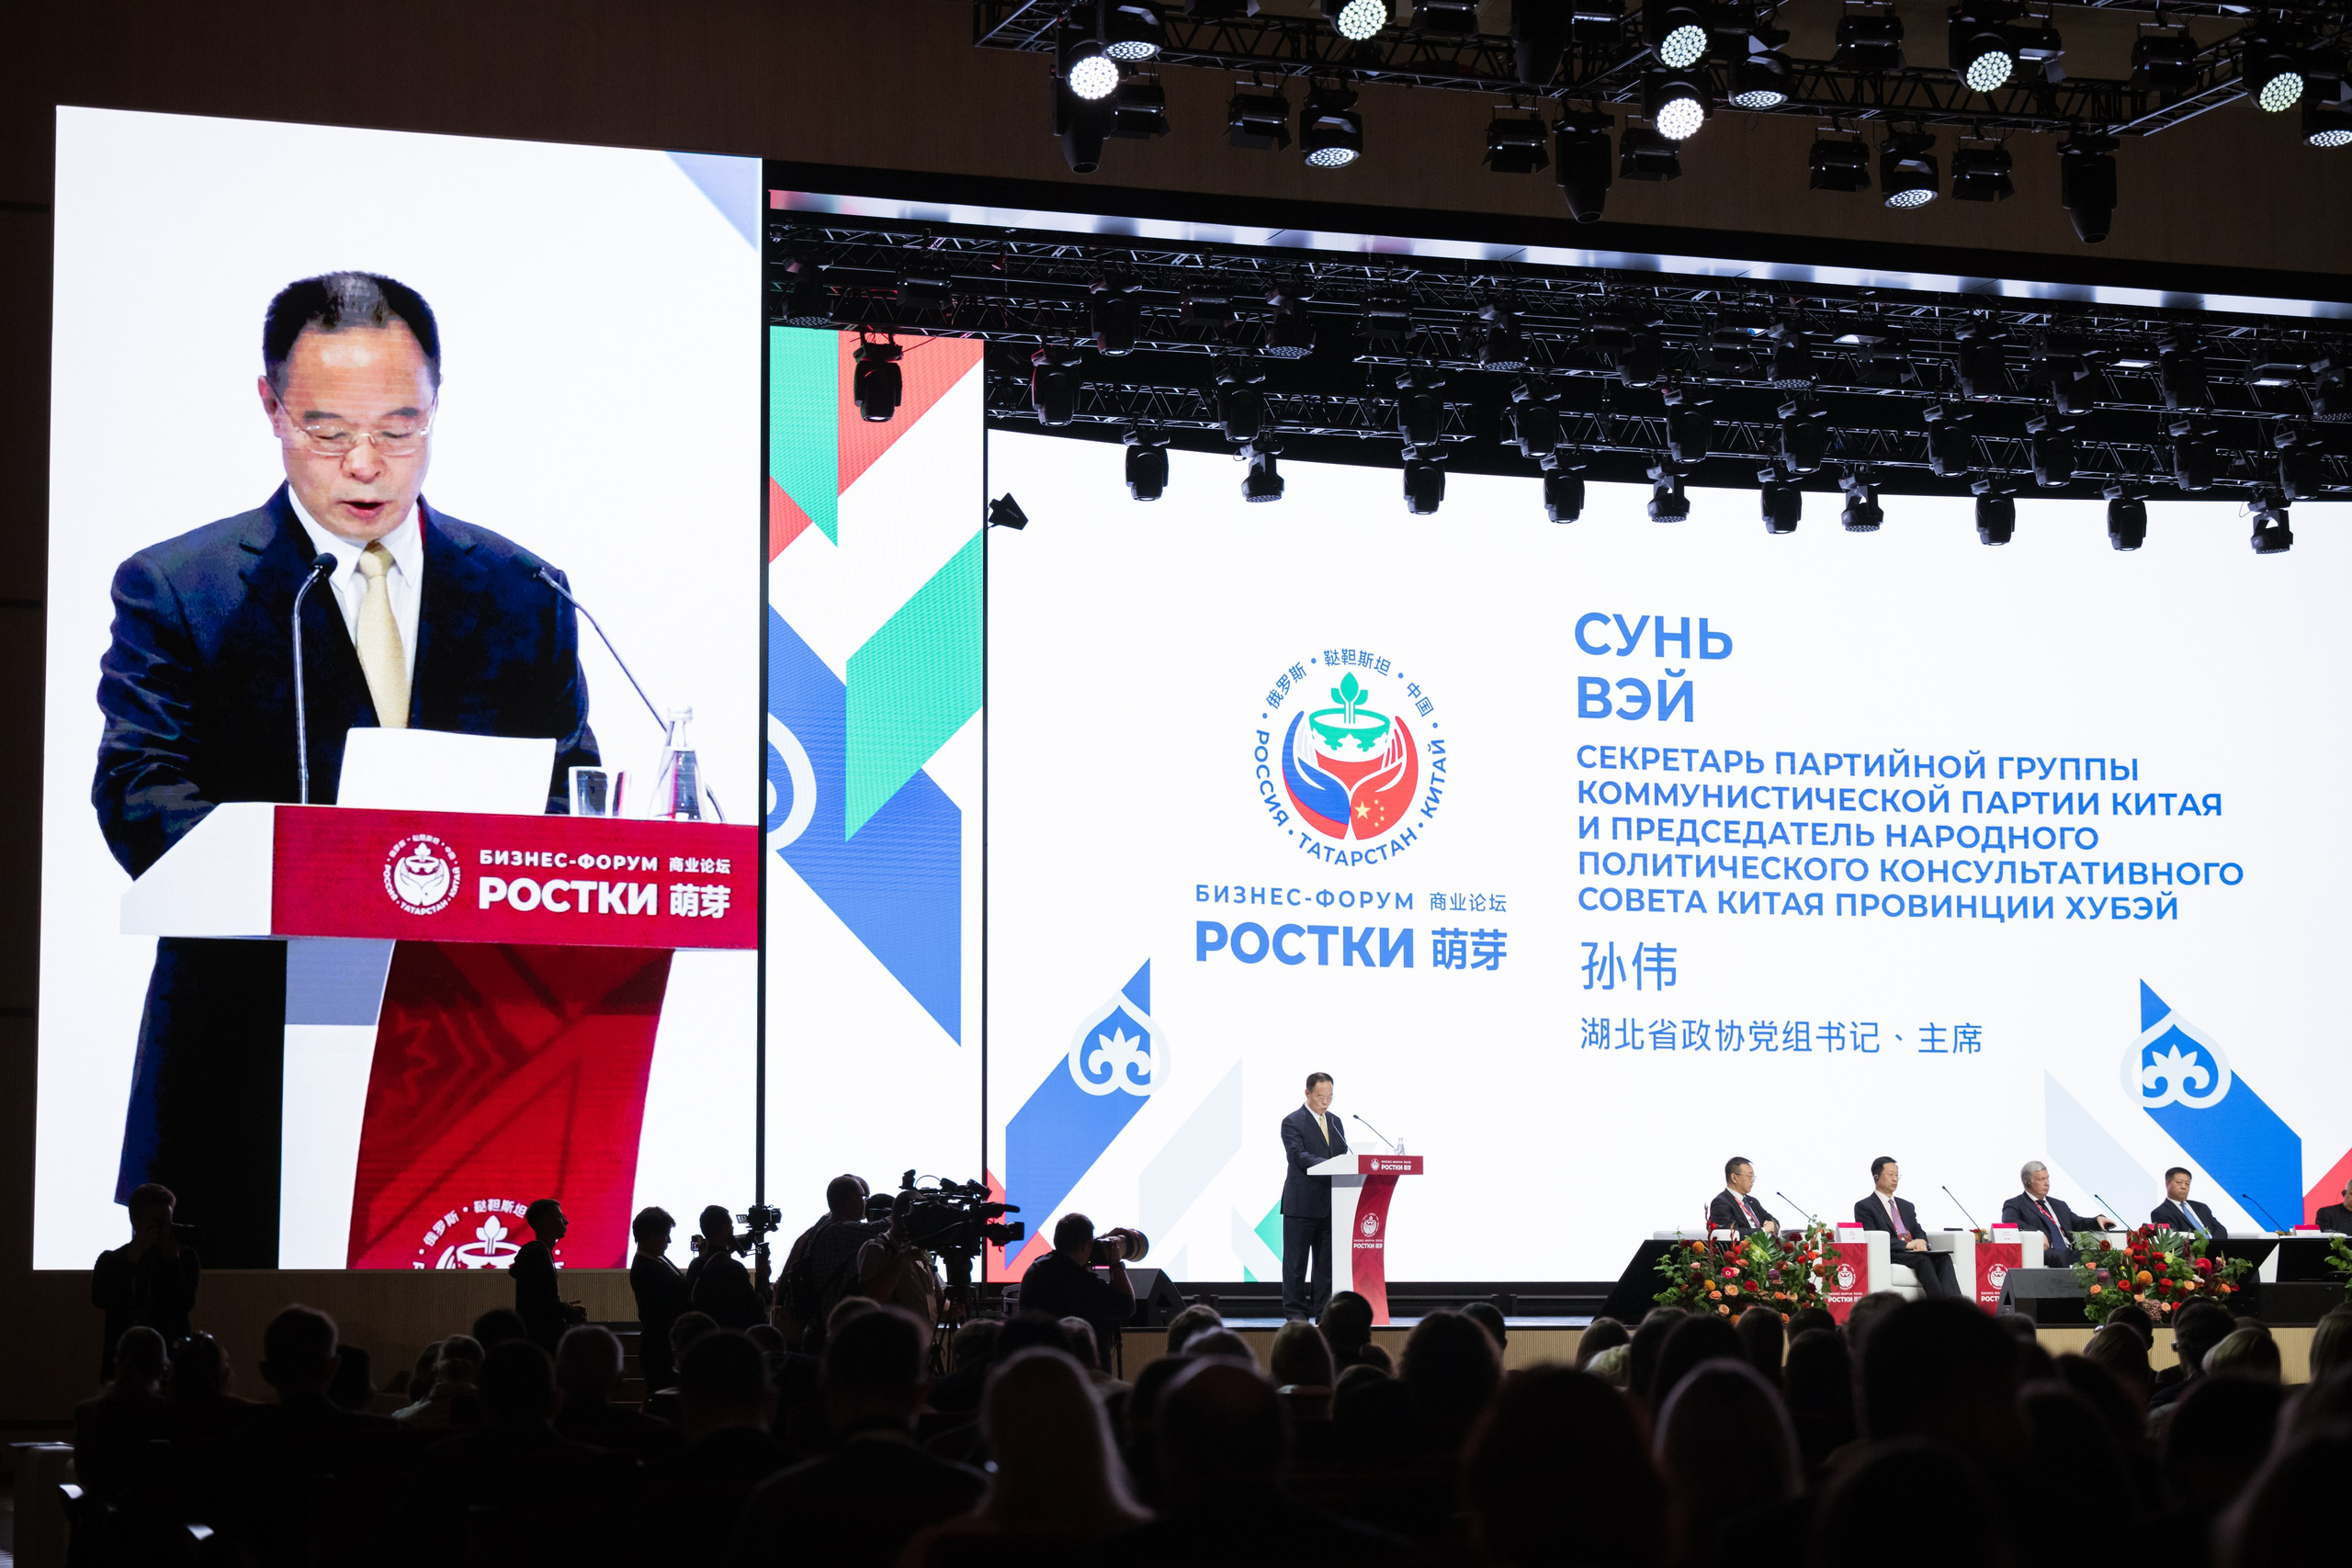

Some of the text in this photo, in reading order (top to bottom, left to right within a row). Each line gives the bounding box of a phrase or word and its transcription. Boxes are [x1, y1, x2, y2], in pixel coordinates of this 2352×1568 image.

[1575, 613, 1733, 660] СУНЬ
[1266, 649, 1433, 716] 俄罗斯 鞑靼斯坦 中国
[1577, 668, 1693, 722] ВЭЙ
[1577, 745, 2138, 781] СЕКРЕТАРЬ ПАРТИЙНОЙ ГРУППЫ
[1254, 729, 1446, 866] РОССИЯ ТАТАРСТАН КИТАЙ
[1578, 781, 2222, 816] КОММУНИСТИЧЕСКОЙ ПАРТИИ КИТАЯ
[1579, 816, 2098, 853] И ПРЕДСЕДАТЕЛЬ НАРОДНОГО
[481, 850, 657, 871] БИЗНЕС-ФОРУМ
[670, 857, 730, 874] 商业论坛
[1579, 852, 2244, 886] ПОЛИТИЧЕСКОГО КОНСУЛЬТАТИВНОГО
[480, 877, 657, 915] РОСТКИ
[670, 884, 730, 918] 萌芽
[1196, 885, 1413, 909] БИЗНЕС-ФОРУМ
[1430, 892, 1506, 912] 商业论坛
[1578, 887, 2177, 923] СОВЕТА КИТАЯ ПРОВИНЦИИ ХУБЭЙ
[1196, 920, 1414, 968] РОСТКИ
[1431, 928, 1507, 971] 萌芽
[1581, 942, 1677, 991] 孙伟
[1581, 1018, 1982, 1054] 湖北省政协党组书记、主席
